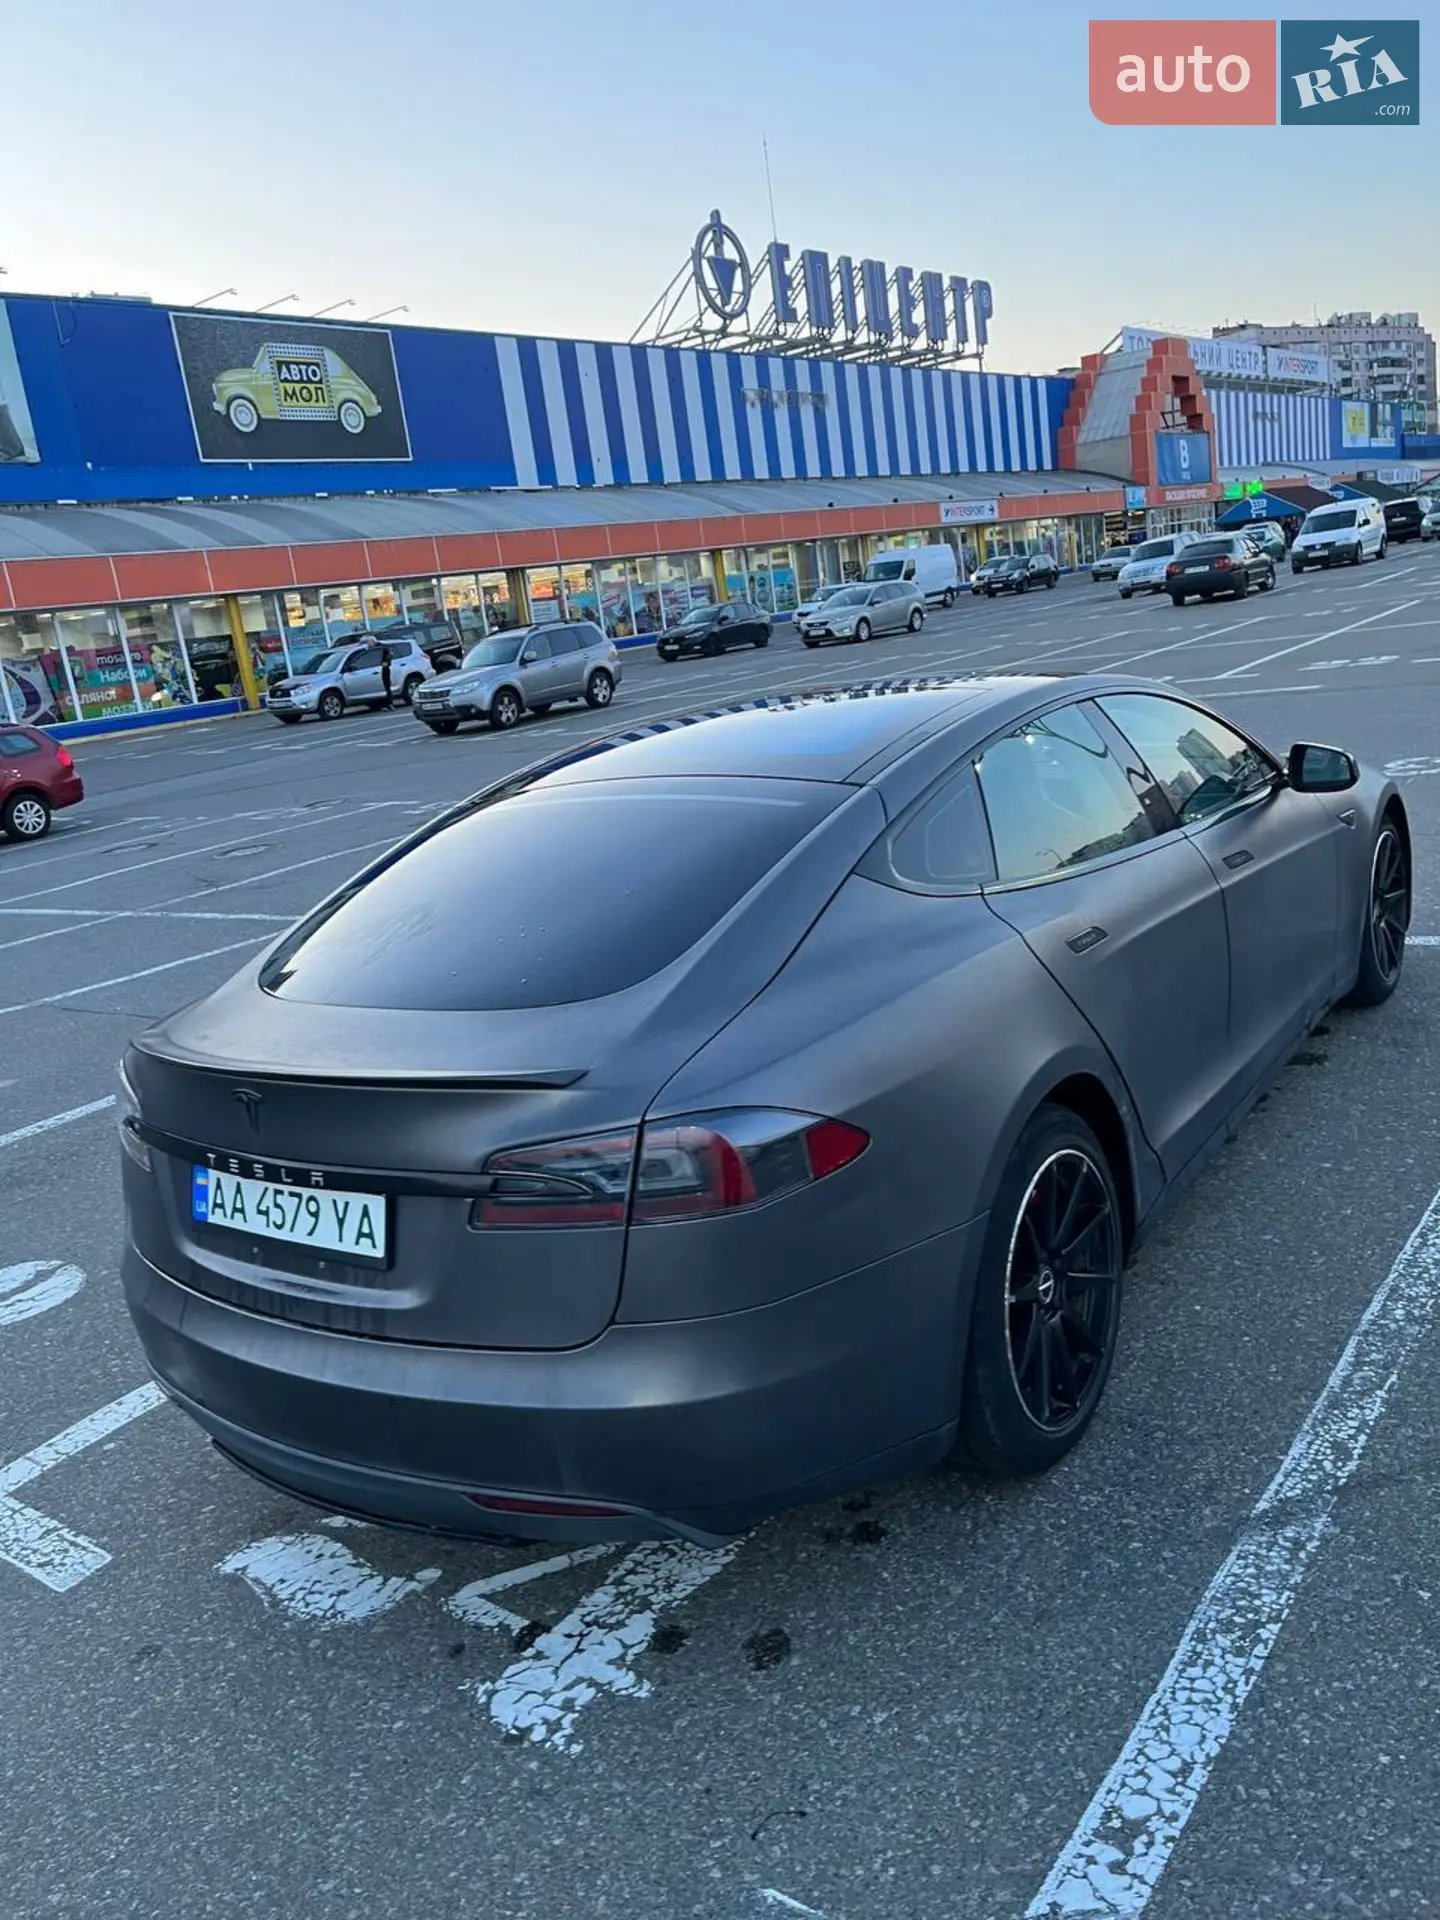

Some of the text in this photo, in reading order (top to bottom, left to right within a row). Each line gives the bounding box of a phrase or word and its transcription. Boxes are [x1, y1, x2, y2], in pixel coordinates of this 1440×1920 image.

[767, 241, 994, 346] ЕПІЦЕНТР
[280, 364, 321, 381] АВТО
[283, 385, 326, 403] МОЛ
[206, 1153, 324, 1187] TESLA
[210, 1176, 377, 1249] AA 4579 YA
